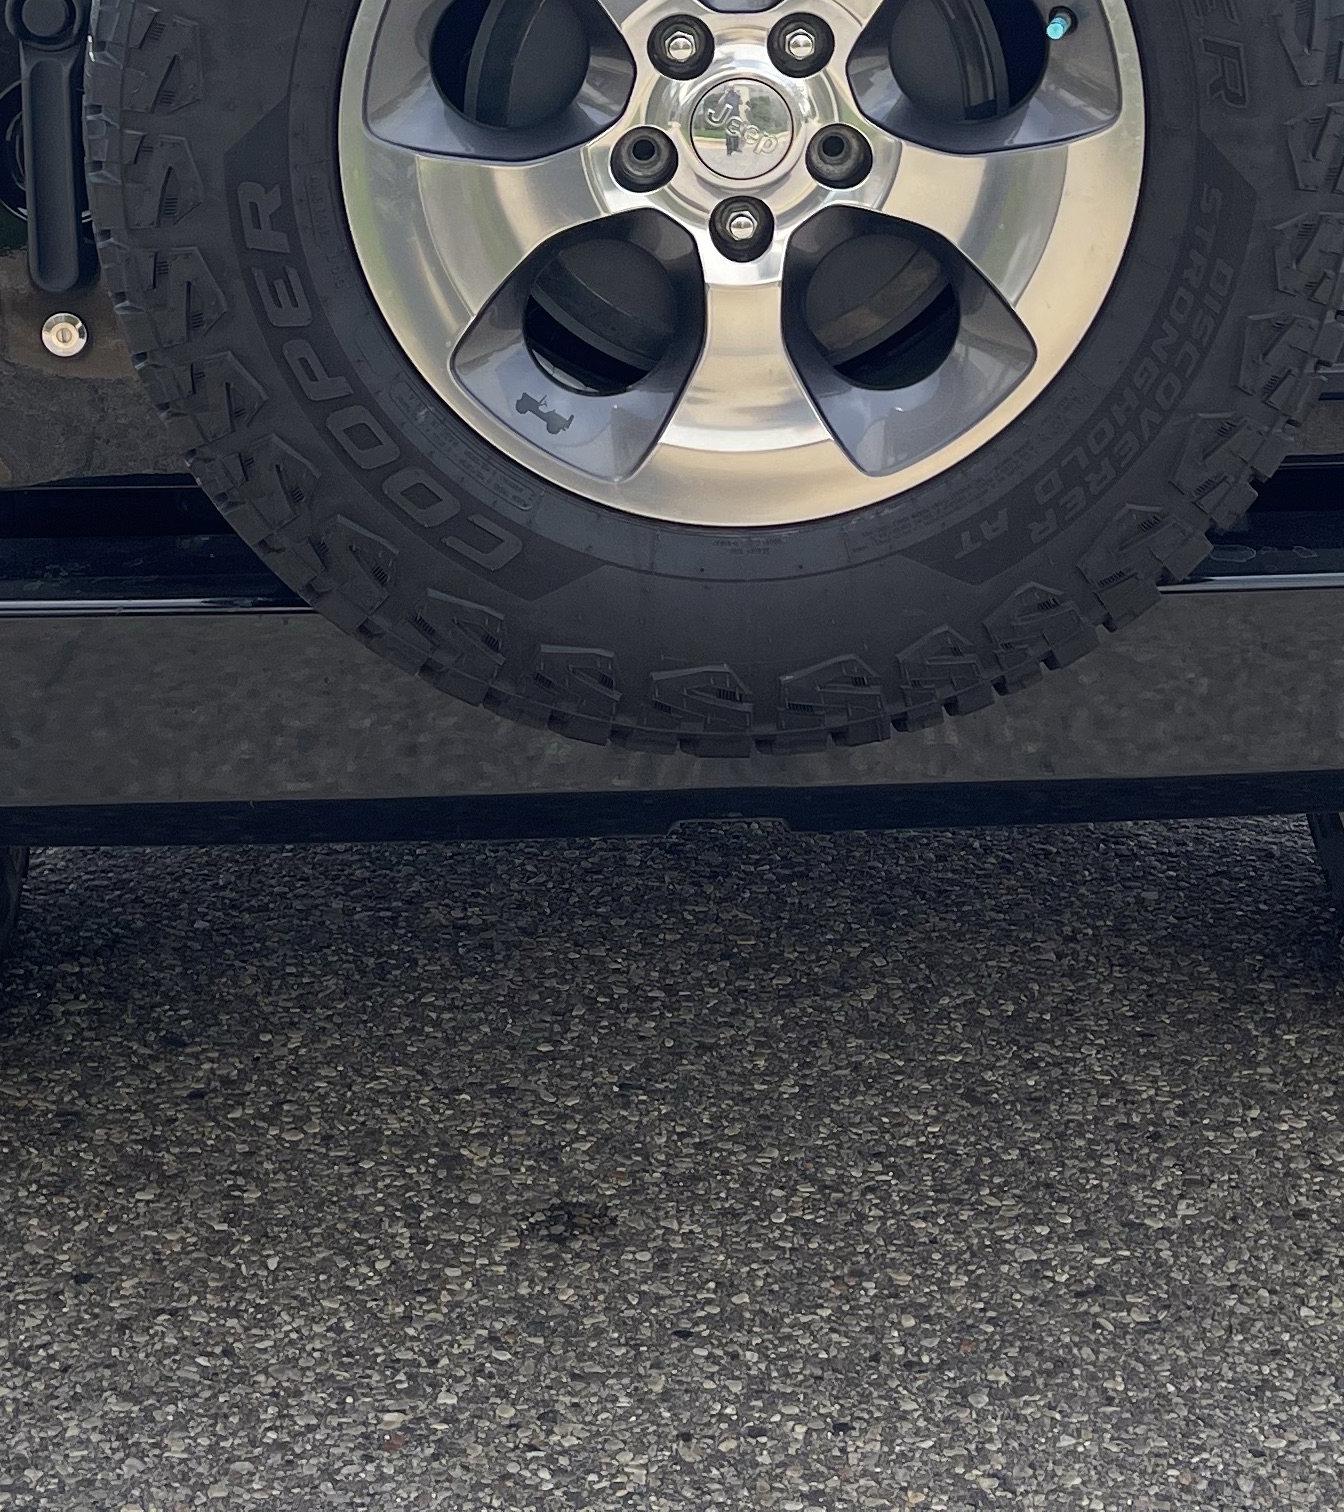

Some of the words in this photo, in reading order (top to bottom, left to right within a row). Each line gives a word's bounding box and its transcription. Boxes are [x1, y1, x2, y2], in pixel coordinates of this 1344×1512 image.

[706, 103, 778, 155] Jeep
[236, 180, 524, 571] COOPER
[1027, 256, 1235, 545] DISCOVERER
[1035, 185, 1223, 504] STRONGHOLD
[955, 509, 1010, 560] AT
